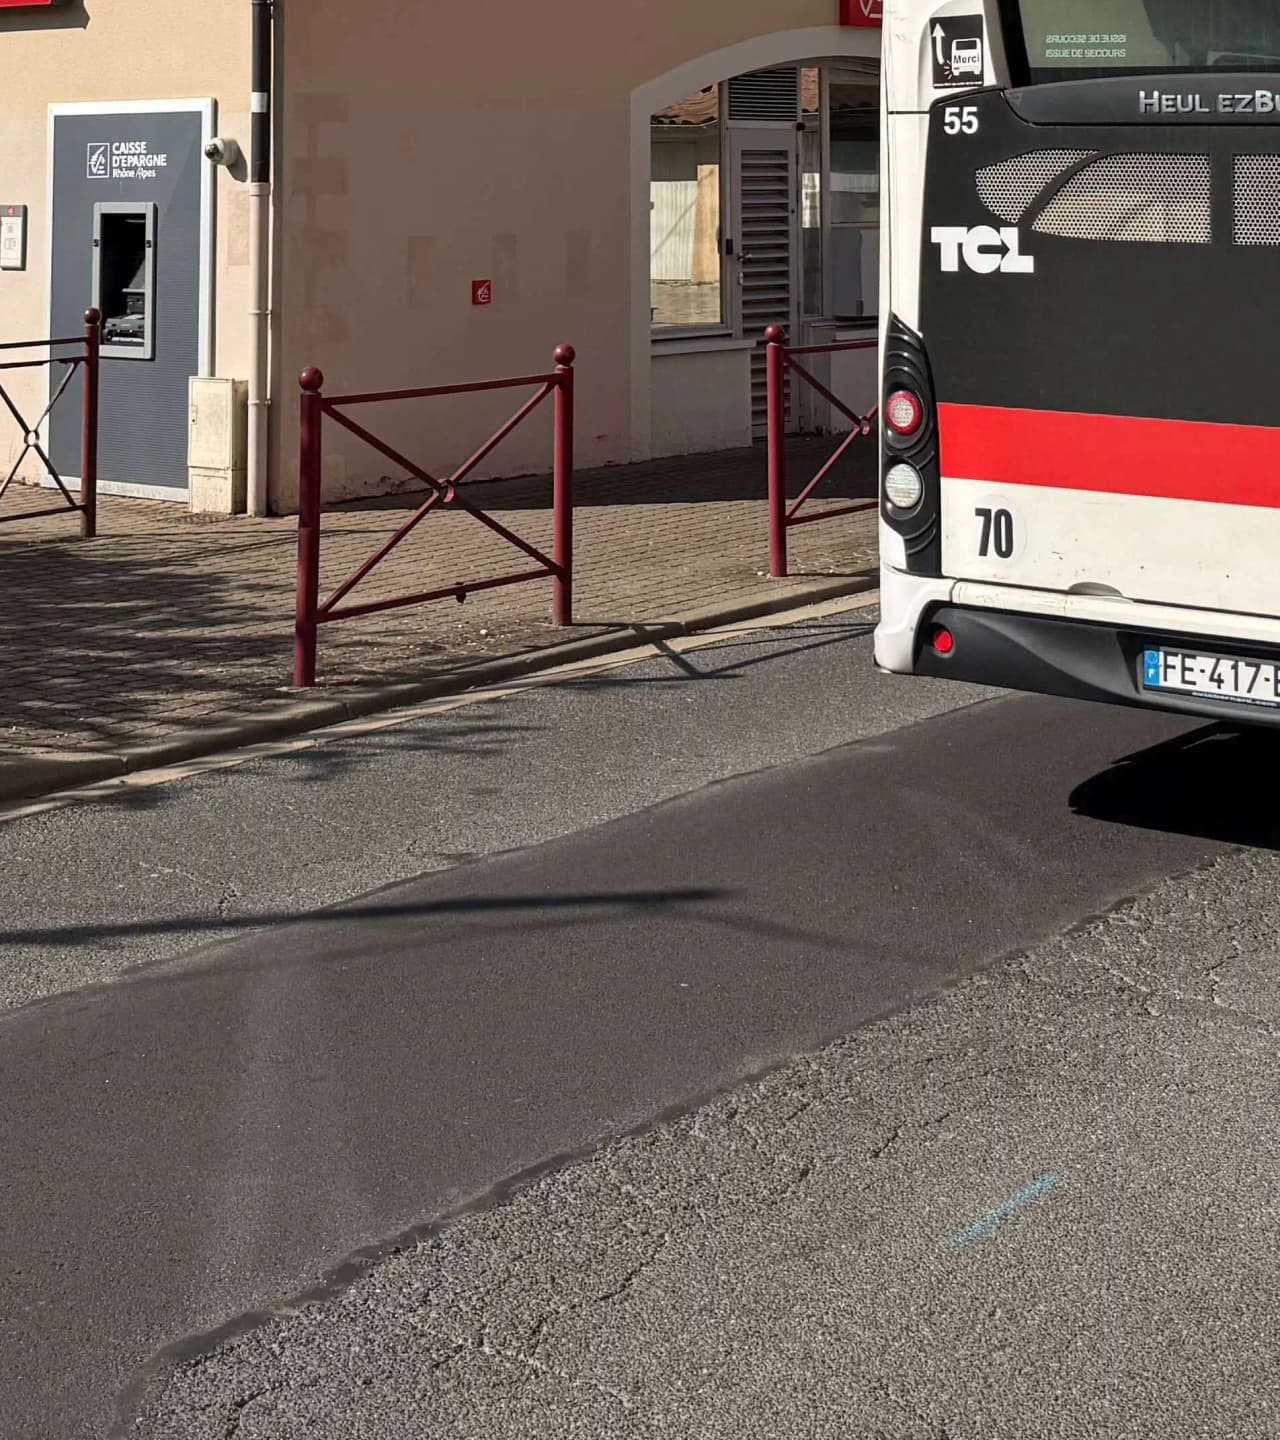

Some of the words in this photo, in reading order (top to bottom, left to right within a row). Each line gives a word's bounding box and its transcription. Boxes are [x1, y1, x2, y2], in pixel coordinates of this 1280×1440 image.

[953, 52, 980, 64] Merci
[943, 106, 979, 135] 55
[112, 142, 147, 154] CAISSE
[112, 154, 167, 167] D'EPARGNE
[931, 225, 1034, 274] TCL
[975, 508, 1013, 558] 70
